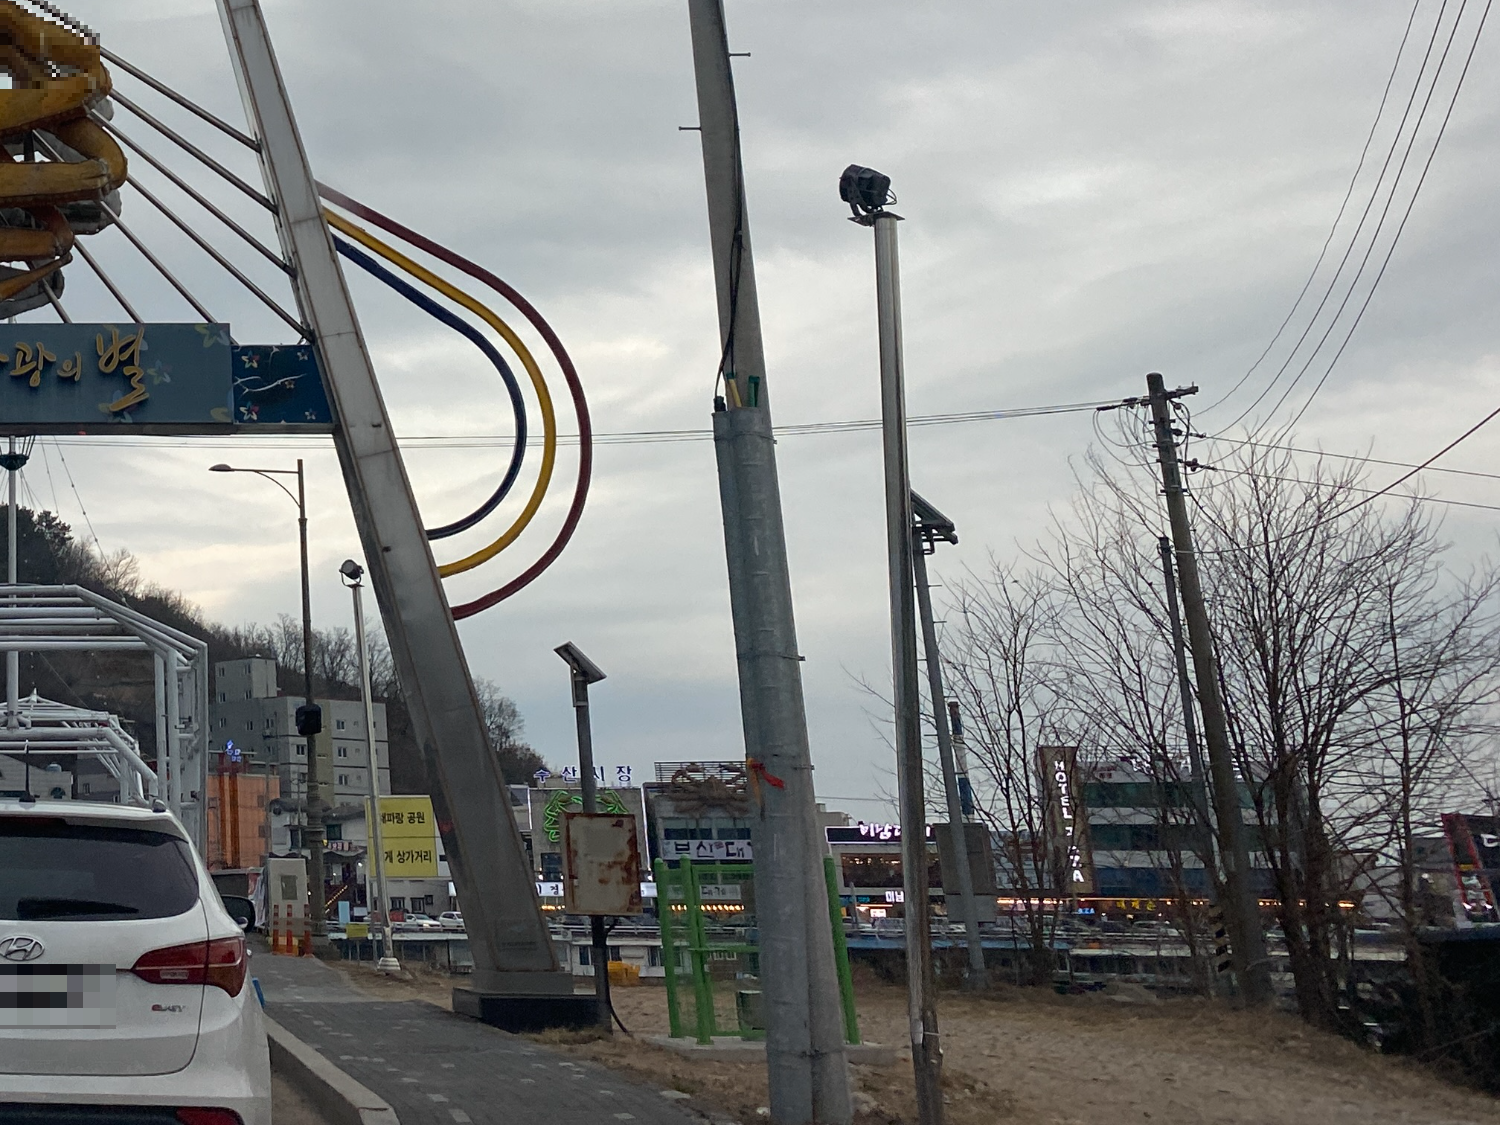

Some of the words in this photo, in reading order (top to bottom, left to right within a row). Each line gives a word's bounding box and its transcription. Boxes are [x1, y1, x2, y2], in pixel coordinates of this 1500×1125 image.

[96, 326, 150, 412] 별
[1054, 760, 1073, 819] MOTEL
[407, 812, 425, 824] 공원
[397, 850, 432, 863] 상가거리
